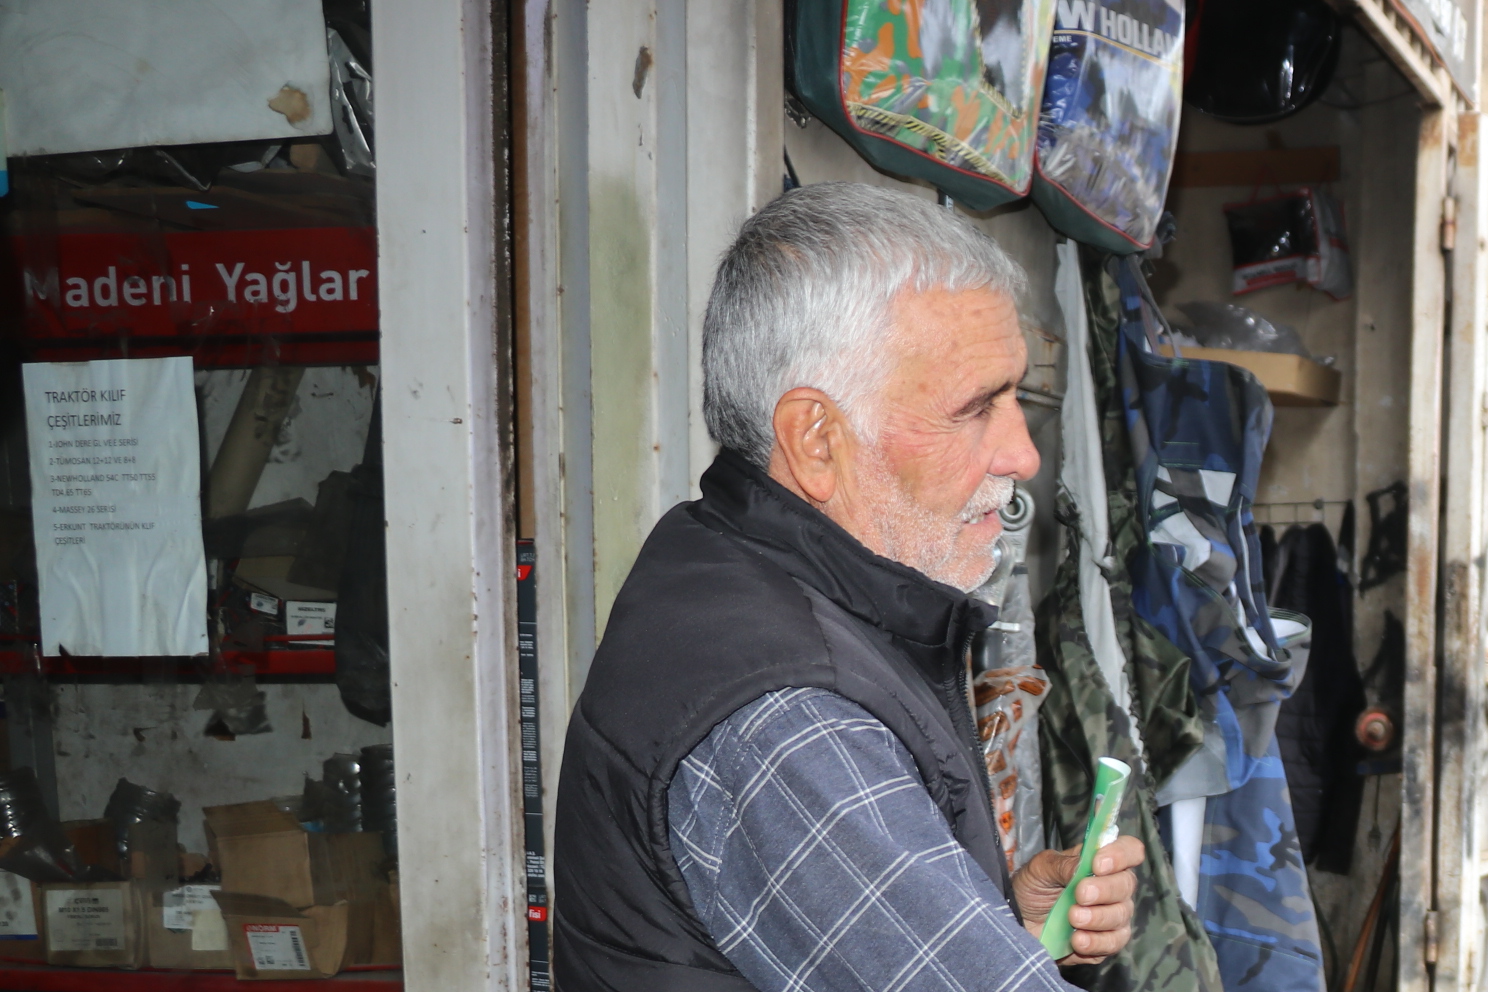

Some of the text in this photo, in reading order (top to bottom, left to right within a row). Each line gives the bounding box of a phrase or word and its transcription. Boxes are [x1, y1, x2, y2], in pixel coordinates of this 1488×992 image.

[24, 261, 370, 313] Madeni Yağlar
[45, 388, 127, 403] TRAKTÖR KILIF
[47, 411, 121, 430] ÇEŞİTLERİMİZ
[75, 439, 92, 448] DERE
[49, 456, 91, 466] 2-TÜMOSAN
[114, 456, 122, 464] VE
[52, 505, 85, 514] 4-MASSEY
[87, 505, 95, 514] 26
